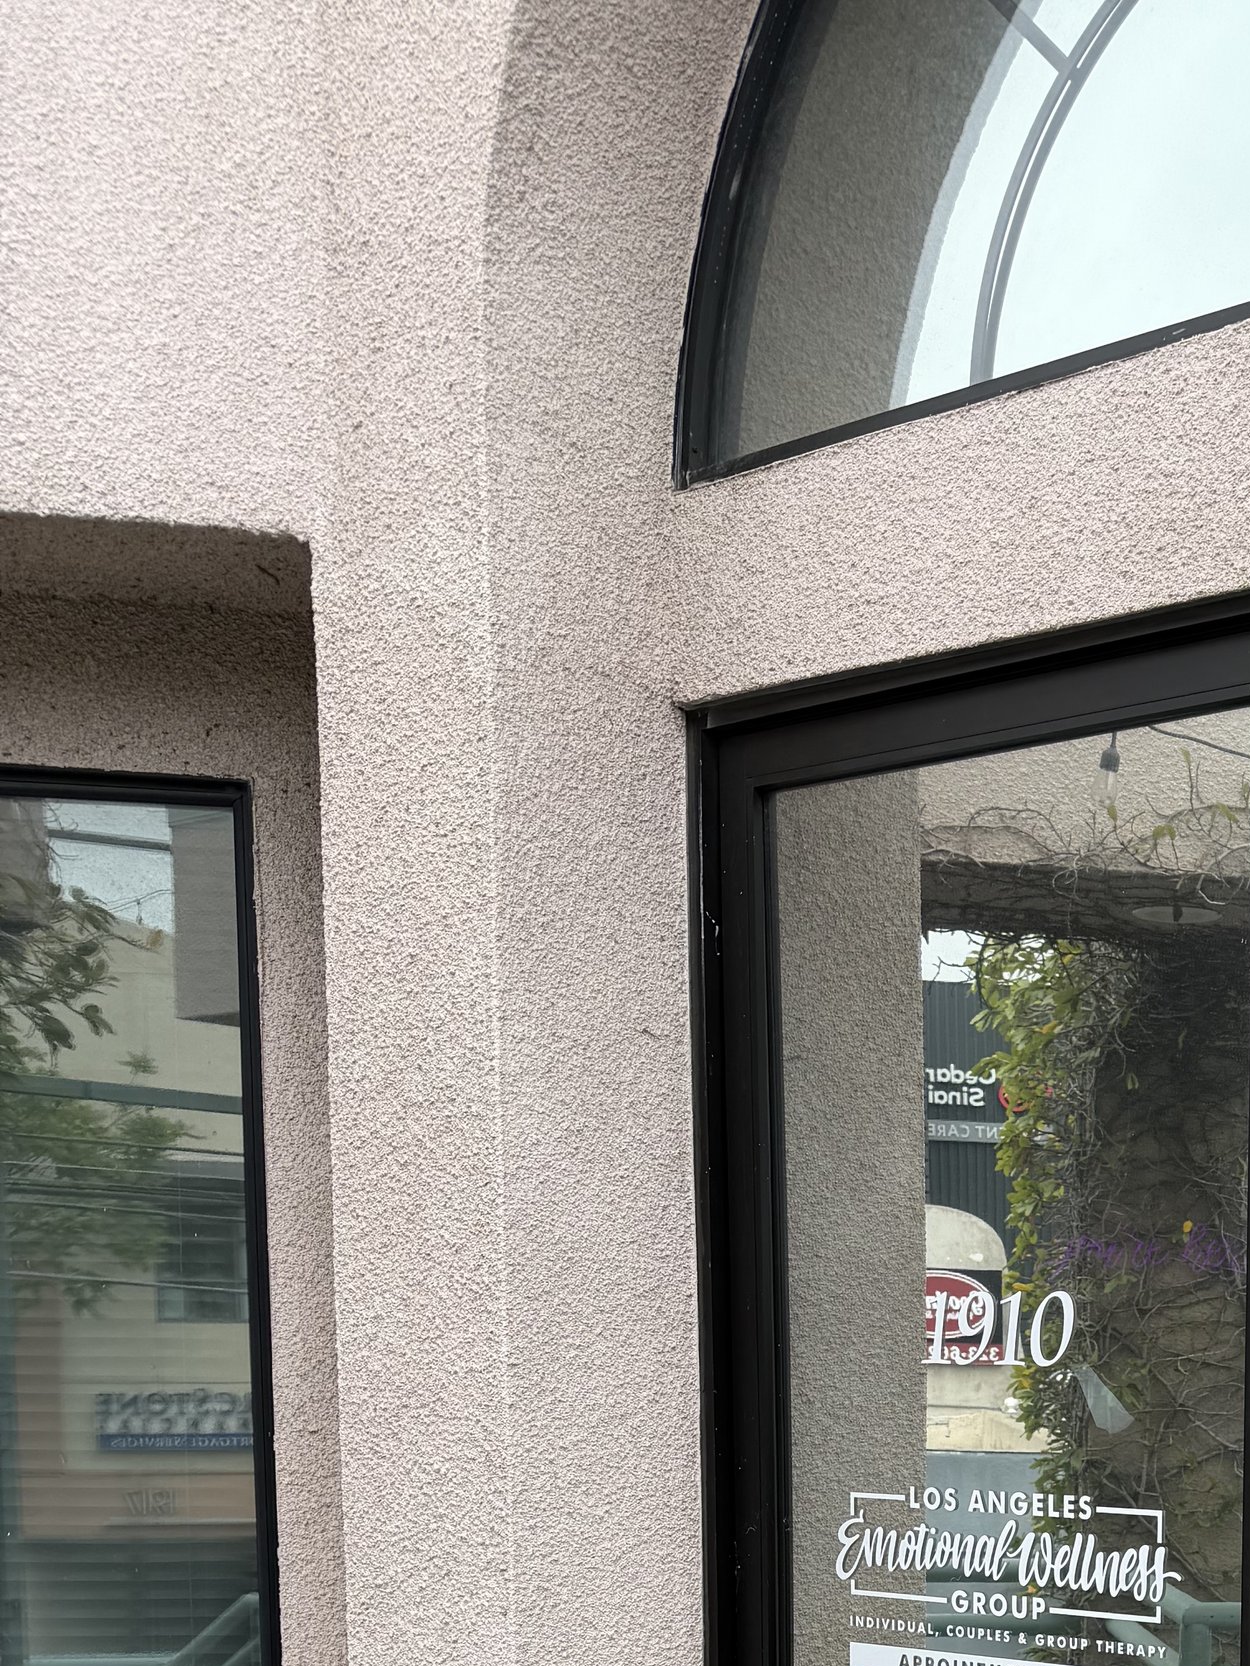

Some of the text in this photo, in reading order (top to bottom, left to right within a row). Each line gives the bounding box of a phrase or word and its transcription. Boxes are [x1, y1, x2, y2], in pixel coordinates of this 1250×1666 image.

[921, 1290, 1075, 1367] 1910
[909, 1486, 1093, 1520] LOS ANGELES
[836, 1509, 1183, 1602] Emotional Wellness
[951, 1590, 1047, 1620] GROUP
[849, 1615, 1167, 1659] INDIVIDUAL, COUPLES & GROUP THERAPY
